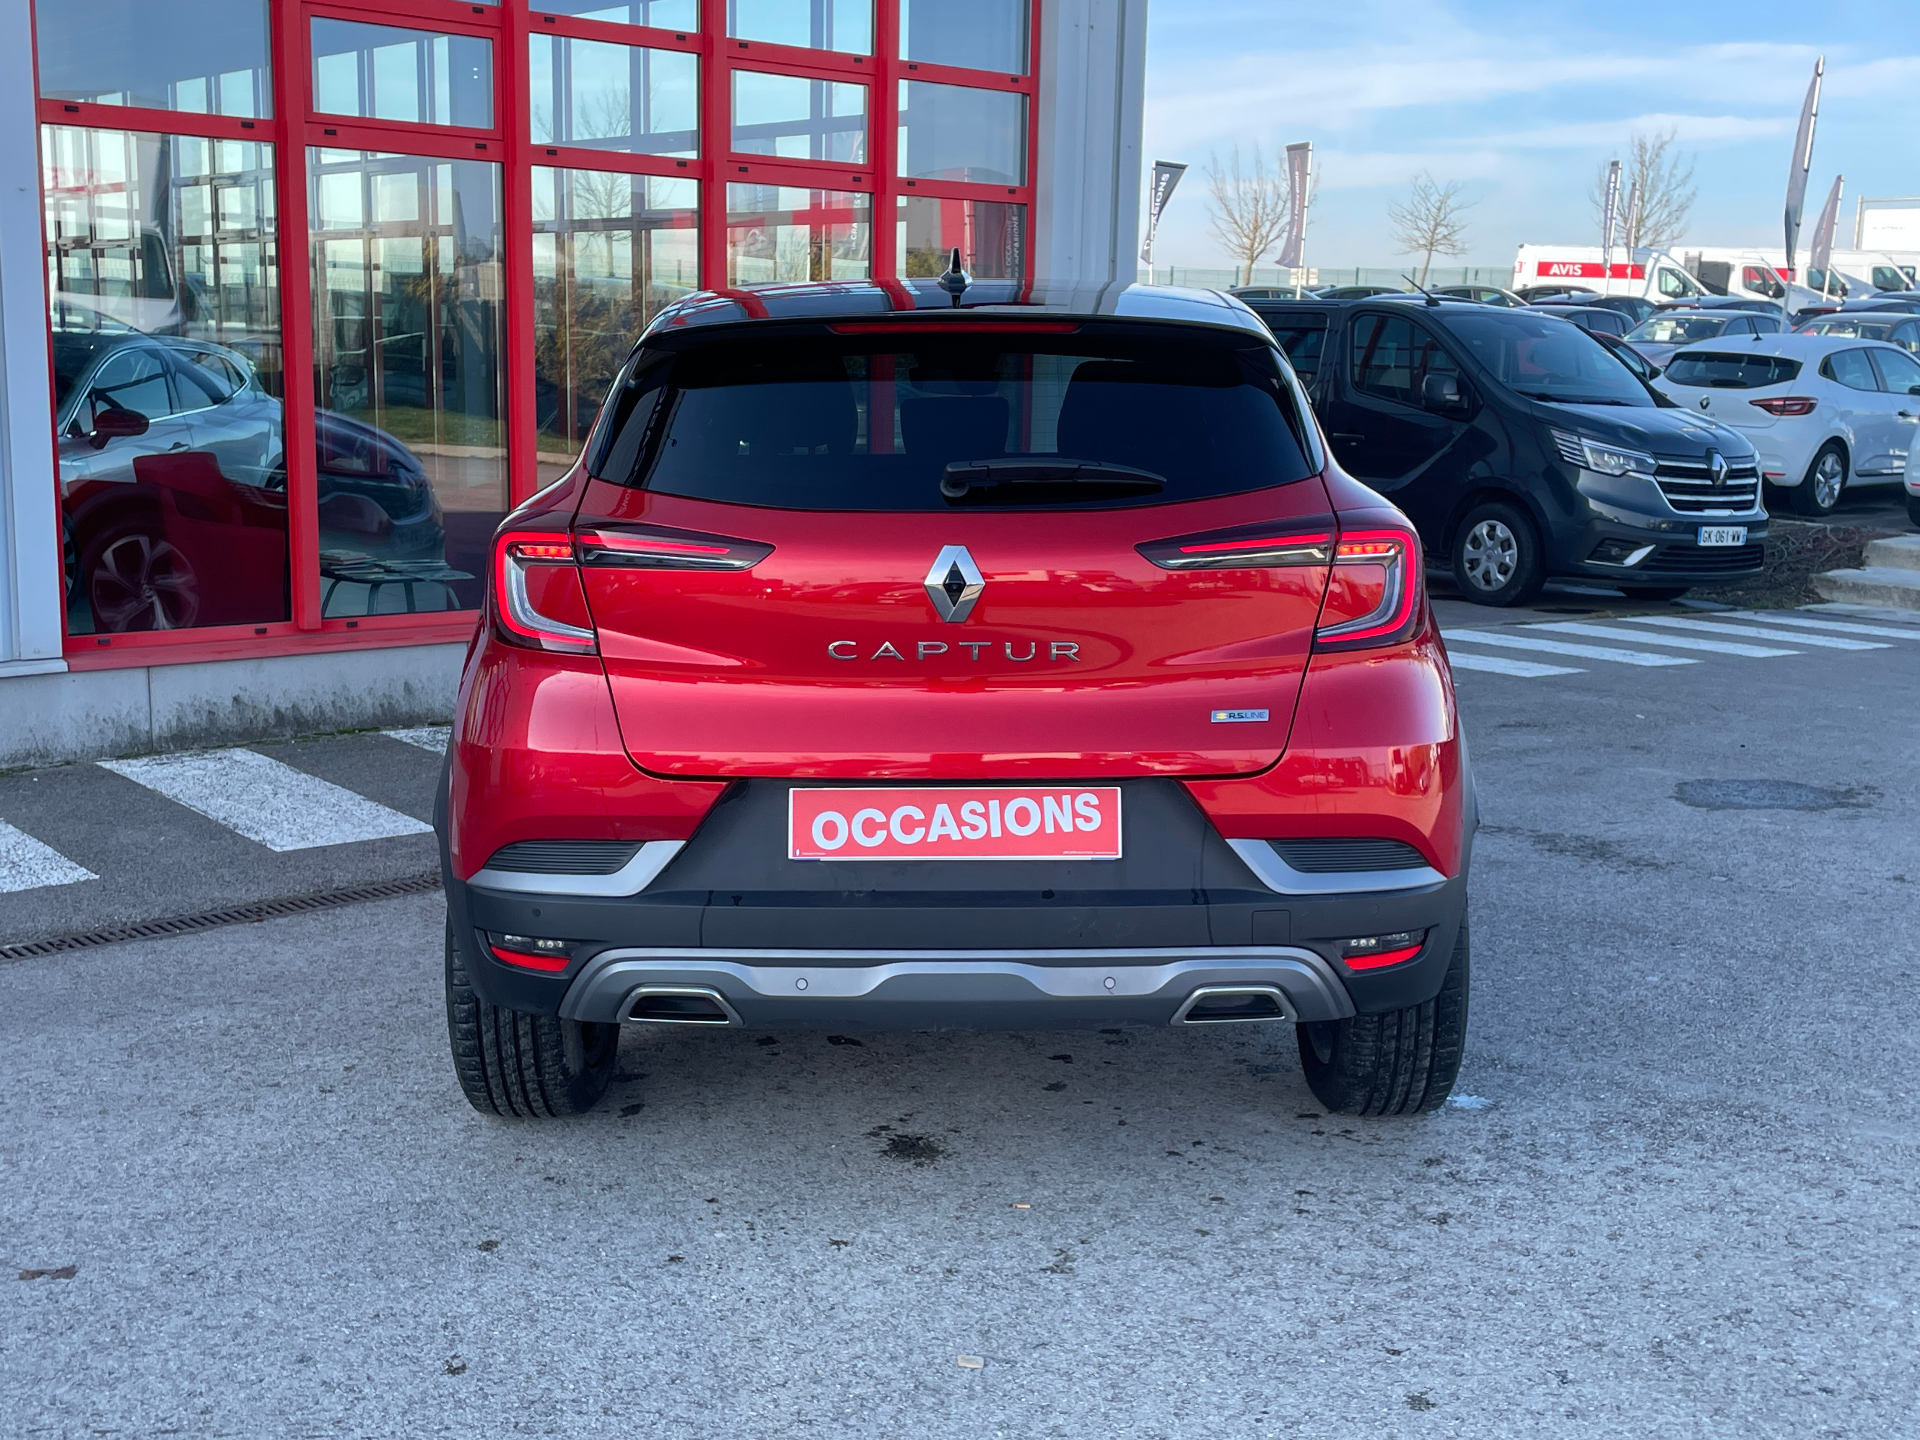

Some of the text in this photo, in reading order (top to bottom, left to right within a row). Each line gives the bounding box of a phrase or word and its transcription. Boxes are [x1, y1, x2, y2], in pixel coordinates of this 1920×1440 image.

[1549, 263, 1583, 276] AVIS
[827, 640, 1081, 662] CAPTUR
[811, 792, 1102, 850] OCCASIONS
